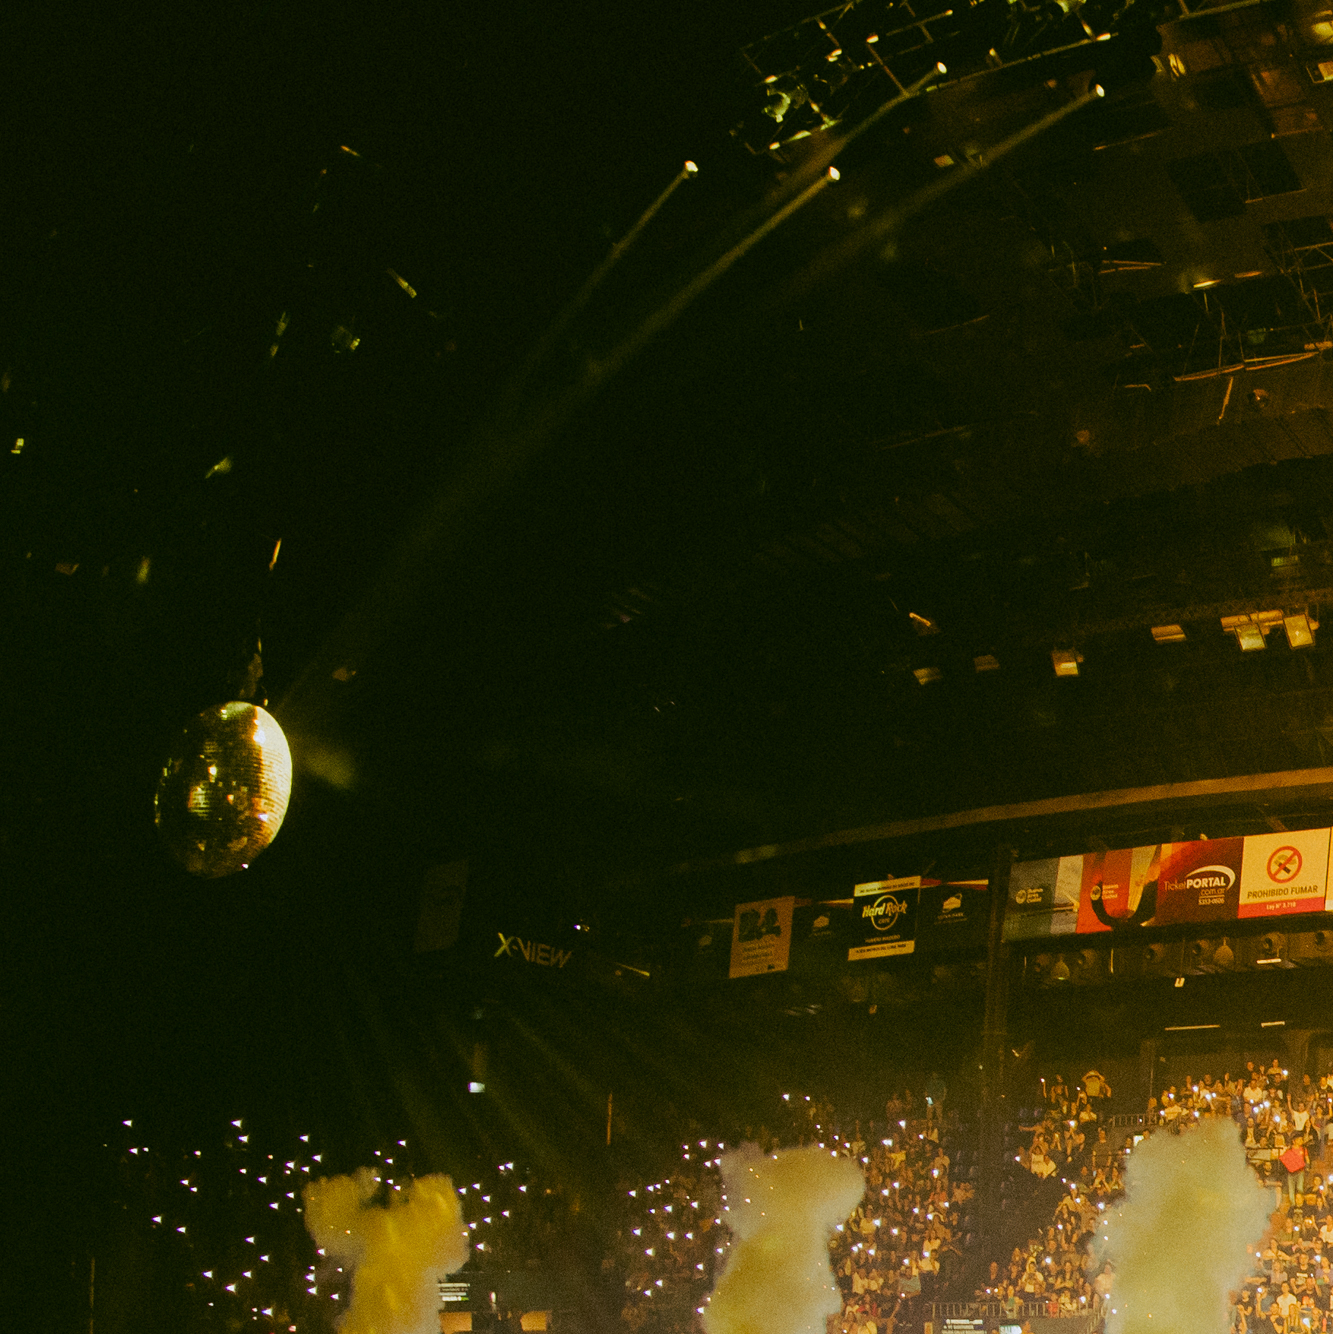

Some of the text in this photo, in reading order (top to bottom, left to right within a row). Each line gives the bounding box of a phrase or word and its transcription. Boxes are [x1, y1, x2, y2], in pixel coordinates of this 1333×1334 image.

[1247, 885, 1318, 899] PROHIBIDO FUMAR
[862, 900, 908, 918] Hard Rock
[494, 932, 572, 968] X-VIEW
